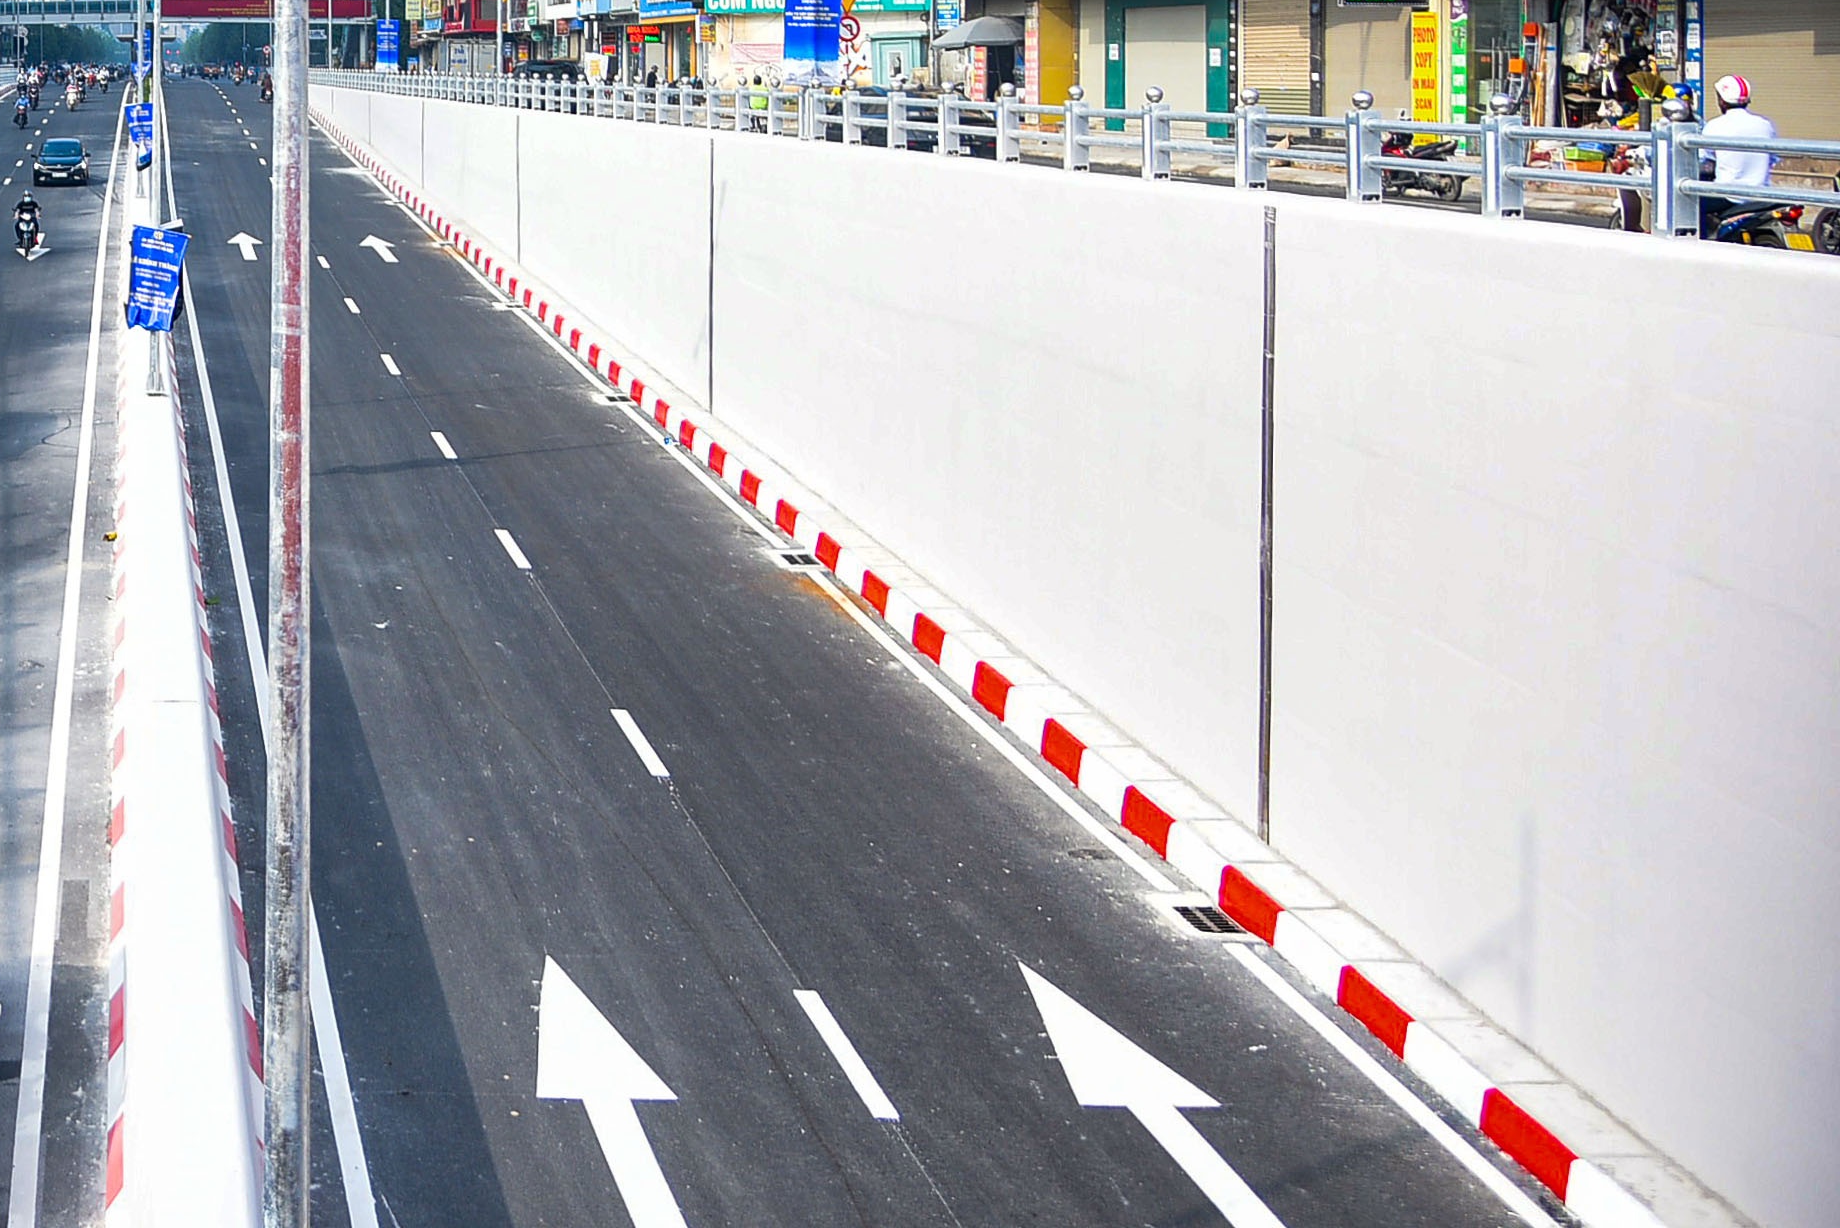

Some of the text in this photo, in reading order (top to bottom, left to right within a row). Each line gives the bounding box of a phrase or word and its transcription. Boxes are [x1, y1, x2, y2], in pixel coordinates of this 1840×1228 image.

[1413, 27, 1435, 43] PHOTO
[1414, 51, 1432, 69] COPY
[1414, 98, 1433, 110] SCAN
